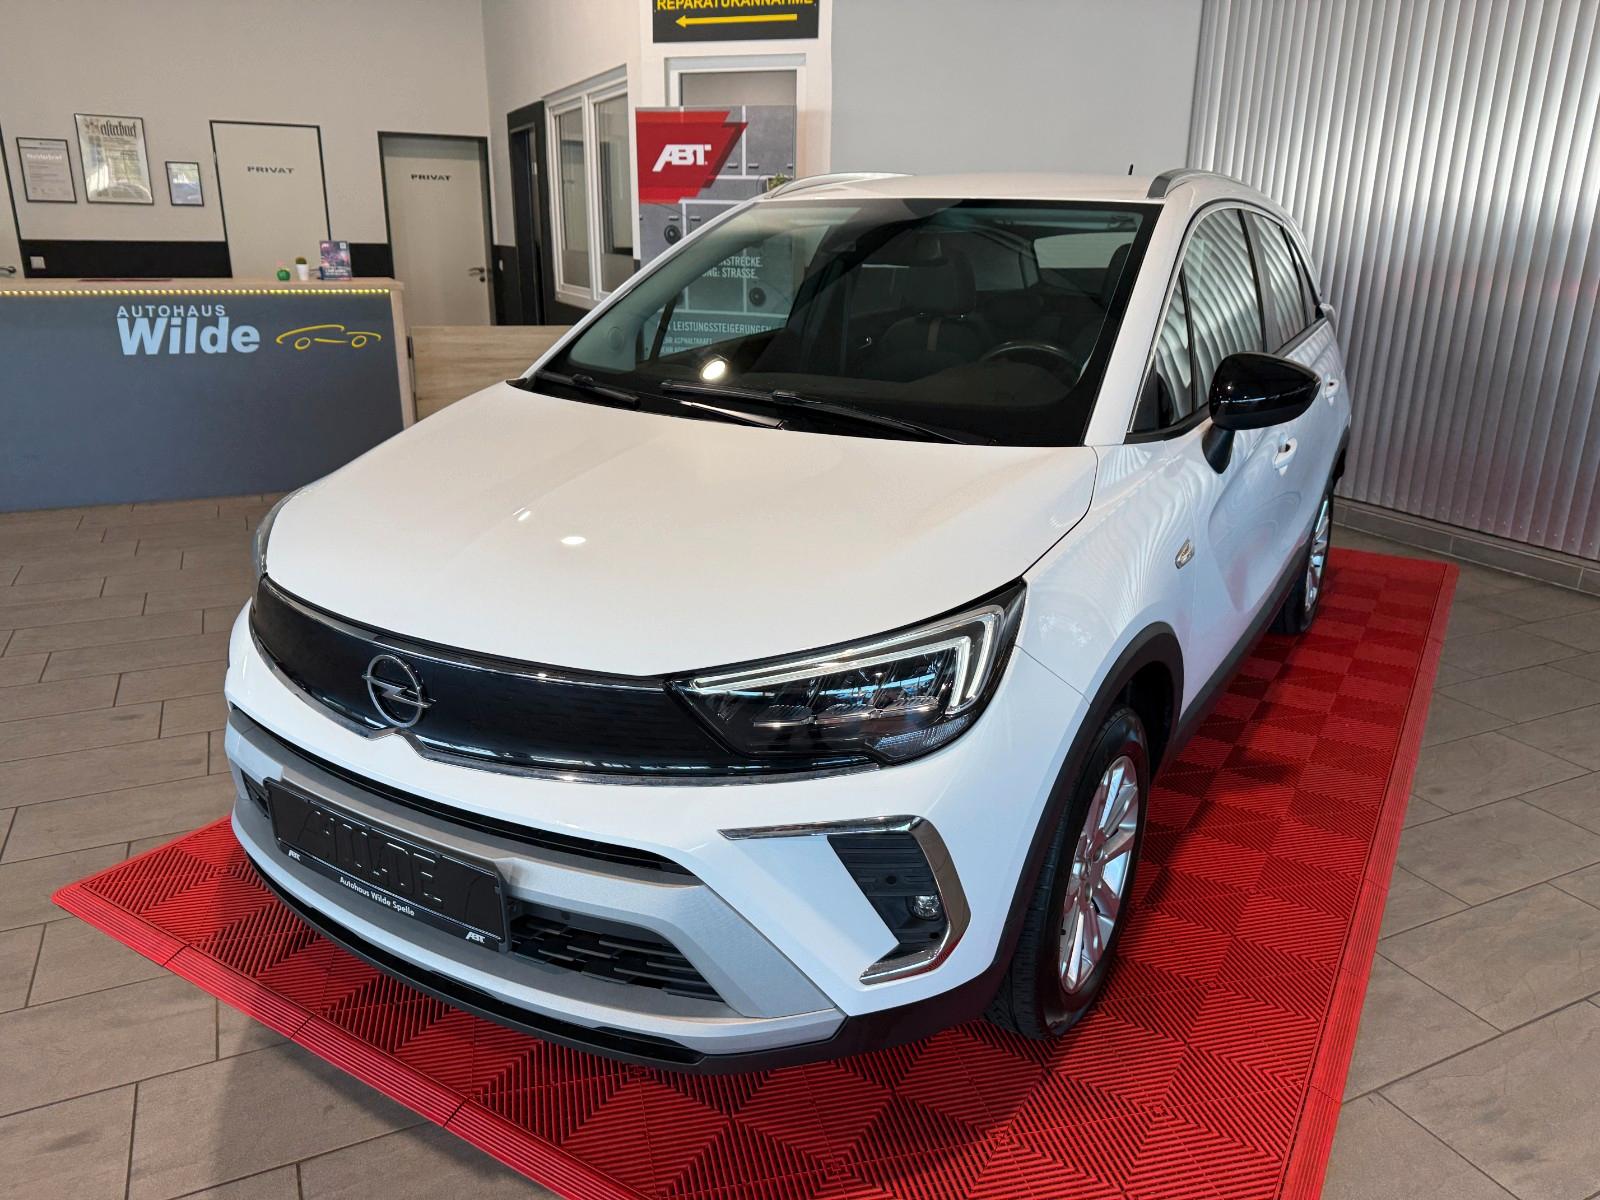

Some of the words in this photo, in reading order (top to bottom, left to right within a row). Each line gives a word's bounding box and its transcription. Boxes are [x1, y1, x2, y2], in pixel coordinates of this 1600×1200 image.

[652, 144, 712, 172] ABT
[247, 166, 294, 175] PRIVAT
[410, 173, 452, 182] PRIVAT
[116, 304, 226, 318] AUTOHAUS
[116, 316, 261, 356] Wilde
[339, 876, 371, 898] Autohaus
[370, 890, 392, 907] Wilde
[465, 930, 486, 945] ABT
